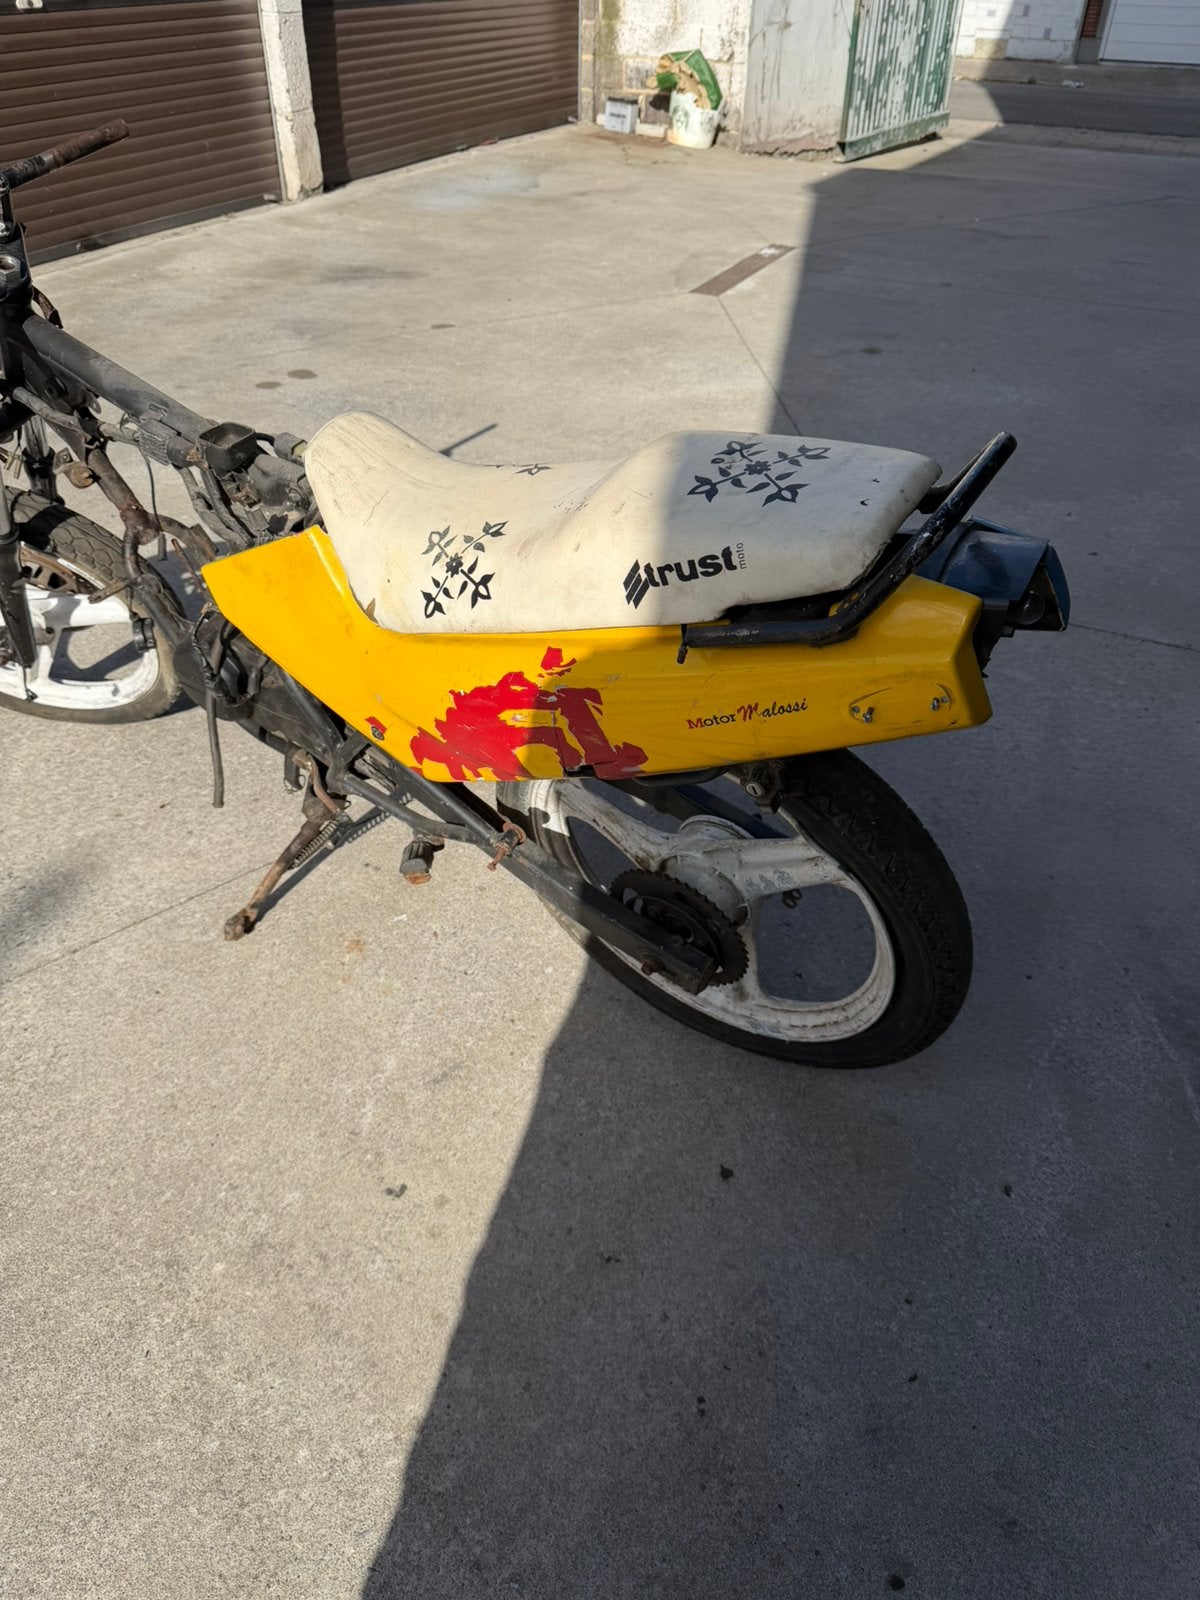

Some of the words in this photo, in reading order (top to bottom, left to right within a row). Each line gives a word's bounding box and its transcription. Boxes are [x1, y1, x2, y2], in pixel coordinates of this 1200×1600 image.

[643, 545, 738, 588] trust
[736, 542, 747, 570] moto
[686, 713, 737, 730] Motor
[736, 698, 808, 722] Malossi
